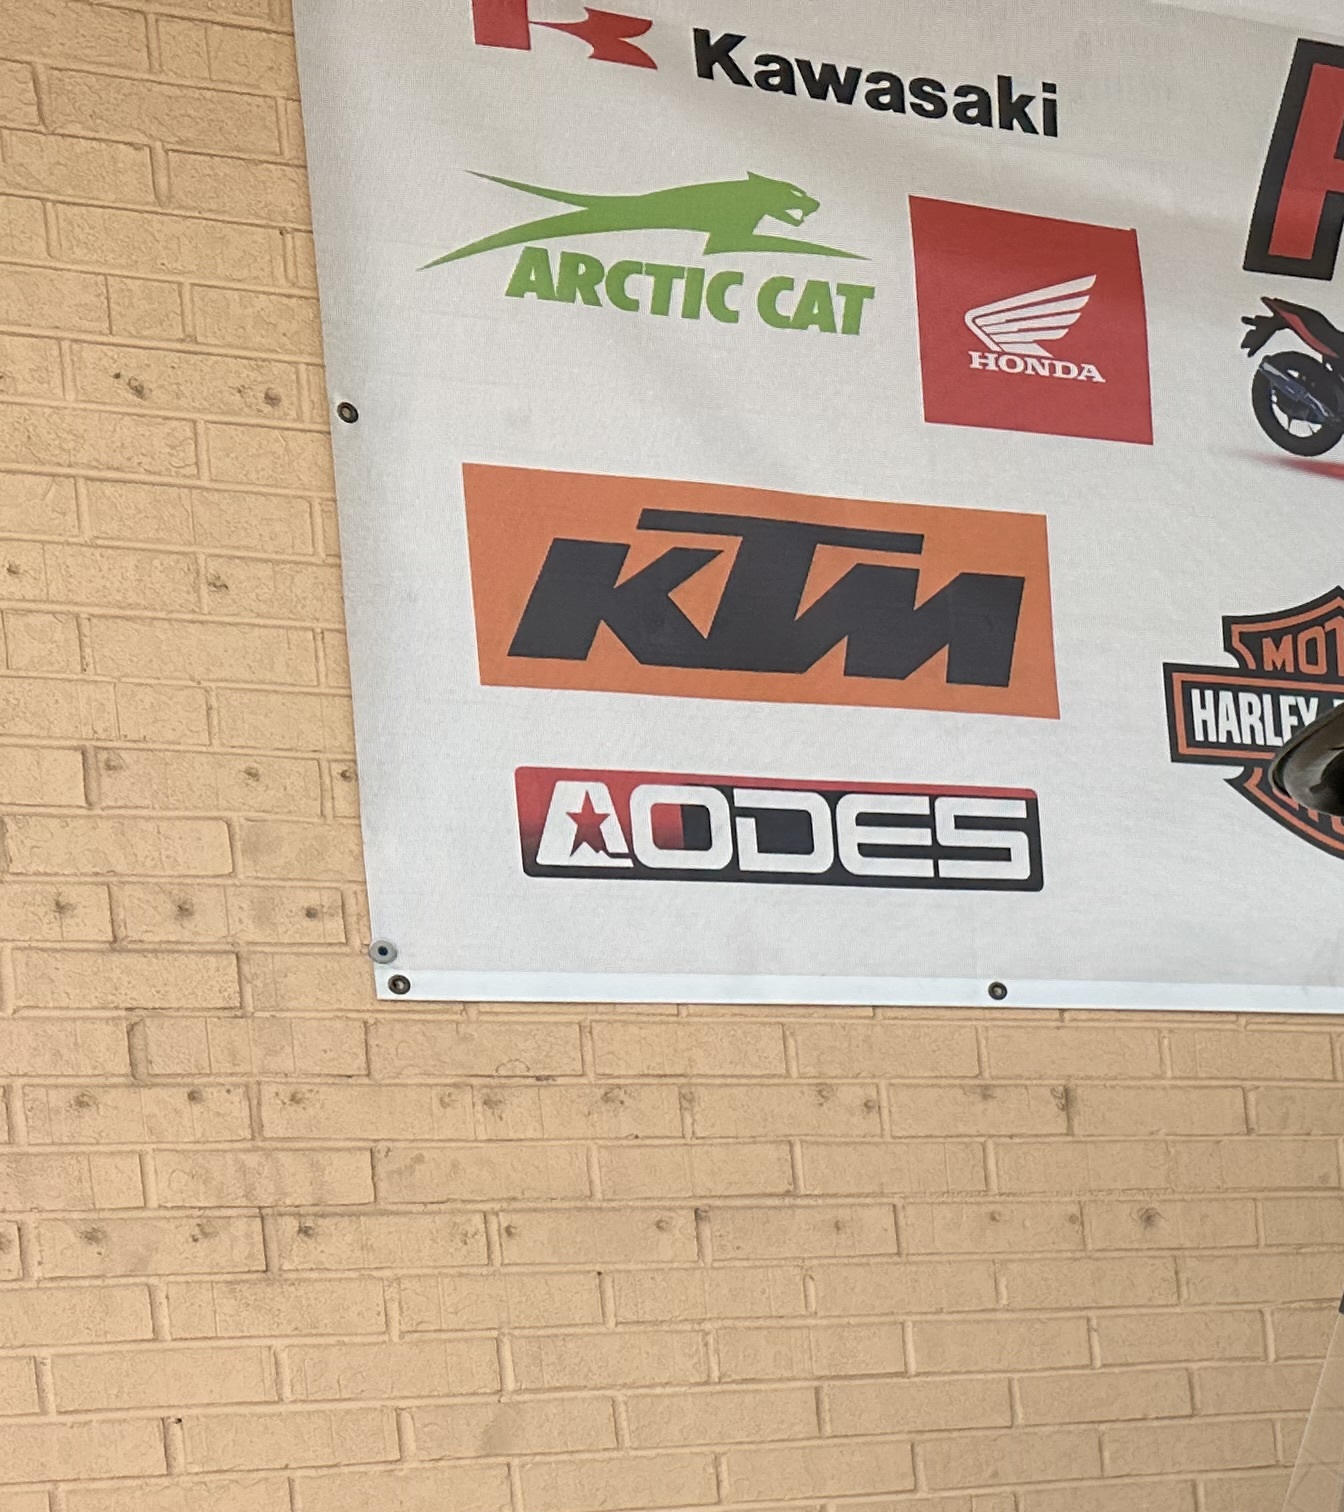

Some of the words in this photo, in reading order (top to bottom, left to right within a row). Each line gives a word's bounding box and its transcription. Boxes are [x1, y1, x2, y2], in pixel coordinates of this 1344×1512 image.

[693, 28, 1060, 138] Kawasaki
[504, 246, 741, 323] ARCTIC
[755, 273, 876, 337] CAT
[969, 349, 1106, 385] HONDA
[507, 508, 1026, 688] KTM
[535, 778, 1034, 881] AODES
